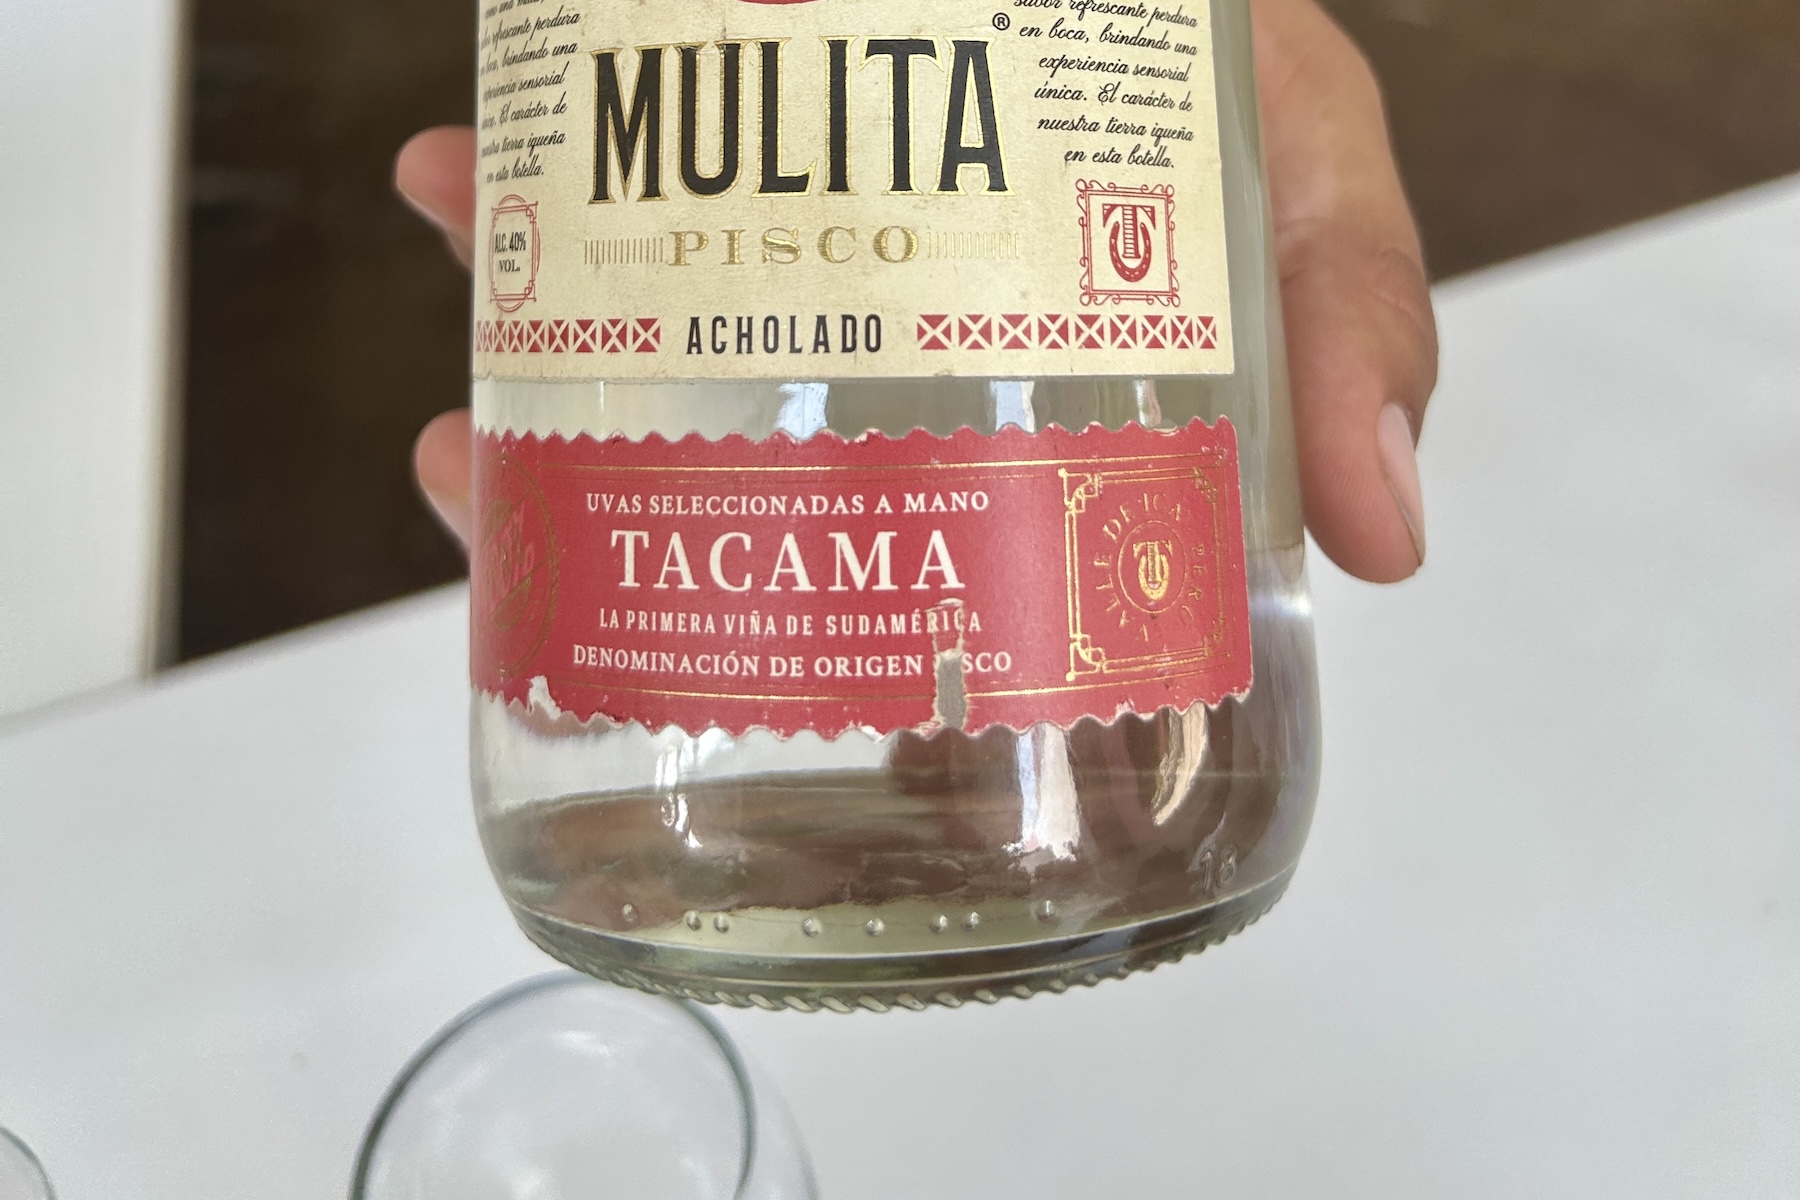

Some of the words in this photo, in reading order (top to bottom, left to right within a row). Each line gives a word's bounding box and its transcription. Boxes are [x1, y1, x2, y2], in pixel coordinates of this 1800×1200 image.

[529, 4, 580, 41] perdura
[1146, 5, 1197, 28] perdura
[552, 43, 578, 57] una
[1019, 26, 1042, 38] en
[1049, 17, 1090, 43] boca,
[1100, 22, 1170, 51] brindando
[1174, 42, 1197, 56] una
[518, 60, 570, 92] sensorial
[1039, 54, 1128, 78] experiencia
[1132, 62, 1192, 82] sensorial
[552, 91, 568, 115] de
[1034, 81, 1087, 101] única.
[1098, 81, 1121, 106] El
[1121, 89, 1175, 109] carácter
[1179, 91, 1193, 112] de
[588, 35, 1016, 204] MULITA
[1037, 114, 1100, 132] nuestra
[1105, 117, 1147, 136] tierra
[1064, 150, 1086, 162] en
[1092, 147, 1122, 163] esta
[1127, 144, 1174, 168] botella.
[509, 231, 526, 251] 40%
[668, 226, 919, 266] PISCO
[686, 314, 883, 355] ACHOLADO
[586, 493, 643, 515] UVAS
[649, 494, 865, 516] SELECCIONADAS
[874, 494, 894, 514] A
[904, 491, 990, 513] MANO
[611, 529, 966, 592] TACAMA
[600, 608, 620, 629] LA
[626, 610, 716, 635] PRIMERA
[724, 610, 778, 636] VIÑA
[786, 614, 814, 636] DE
[826, 608, 982, 636] SUDAMÉRICA
[573, 644, 760, 677] DENOMINACIÓN
[769, 655, 805, 677] DE
[814, 654, 923, 677] ORIGEN
[934, 651, 1012, 674] SCO
